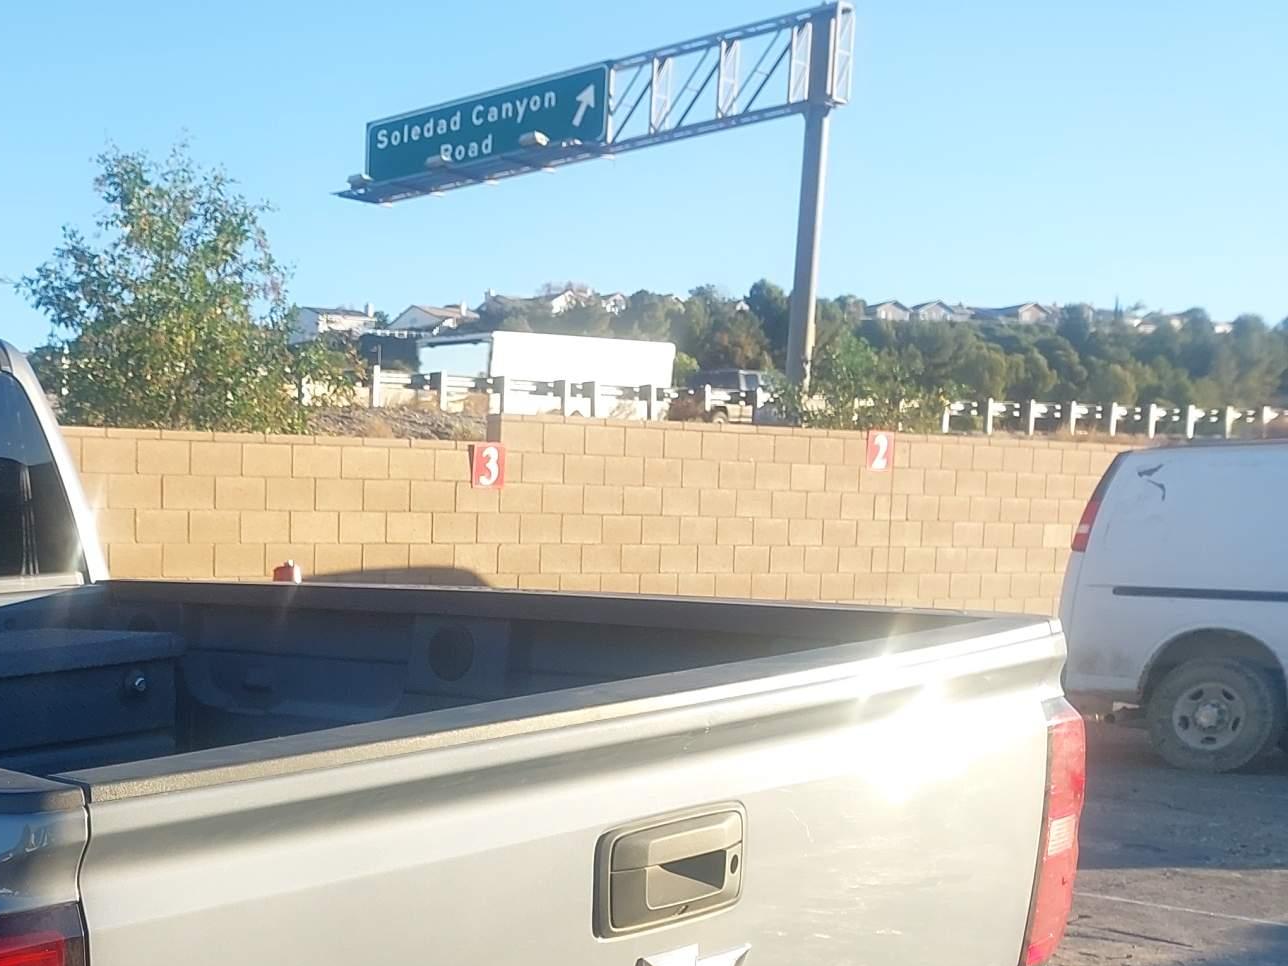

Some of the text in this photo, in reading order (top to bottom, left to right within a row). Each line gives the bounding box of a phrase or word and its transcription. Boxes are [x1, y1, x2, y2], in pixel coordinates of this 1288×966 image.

[377, 91, 556, 149] Soledad Canyon
[440, 134, 492, 161] Road
[479, 446, 499, 486] 3
[871, 433, 888, 469] 2
